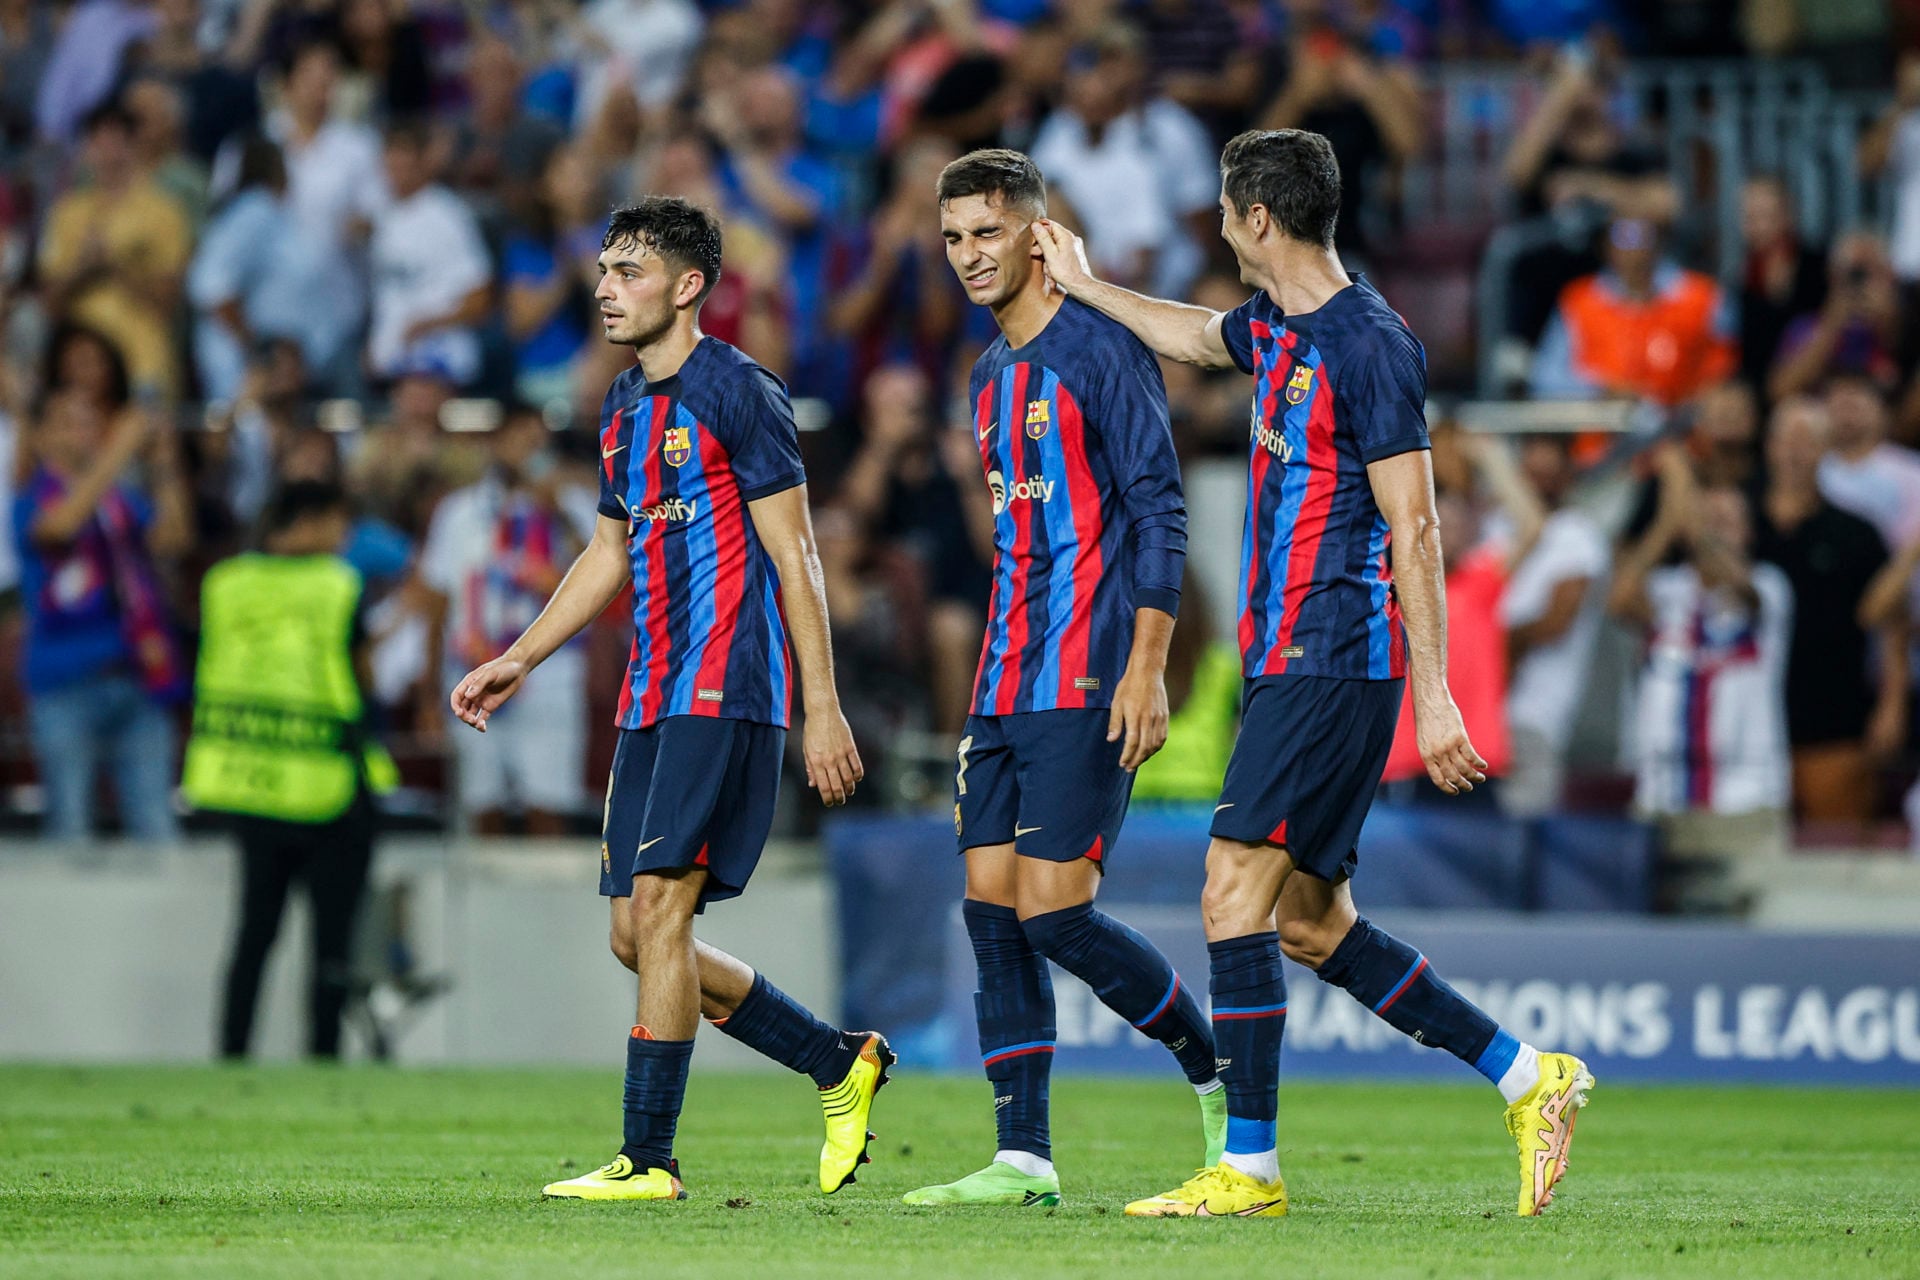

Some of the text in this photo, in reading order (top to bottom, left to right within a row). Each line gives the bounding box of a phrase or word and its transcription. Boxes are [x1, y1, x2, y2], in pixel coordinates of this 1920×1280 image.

[1008, 474, 1055, 503] otify
[630, 498, 697, 525] Spotify
[1207, 977, 1673, 1060] AIONS
